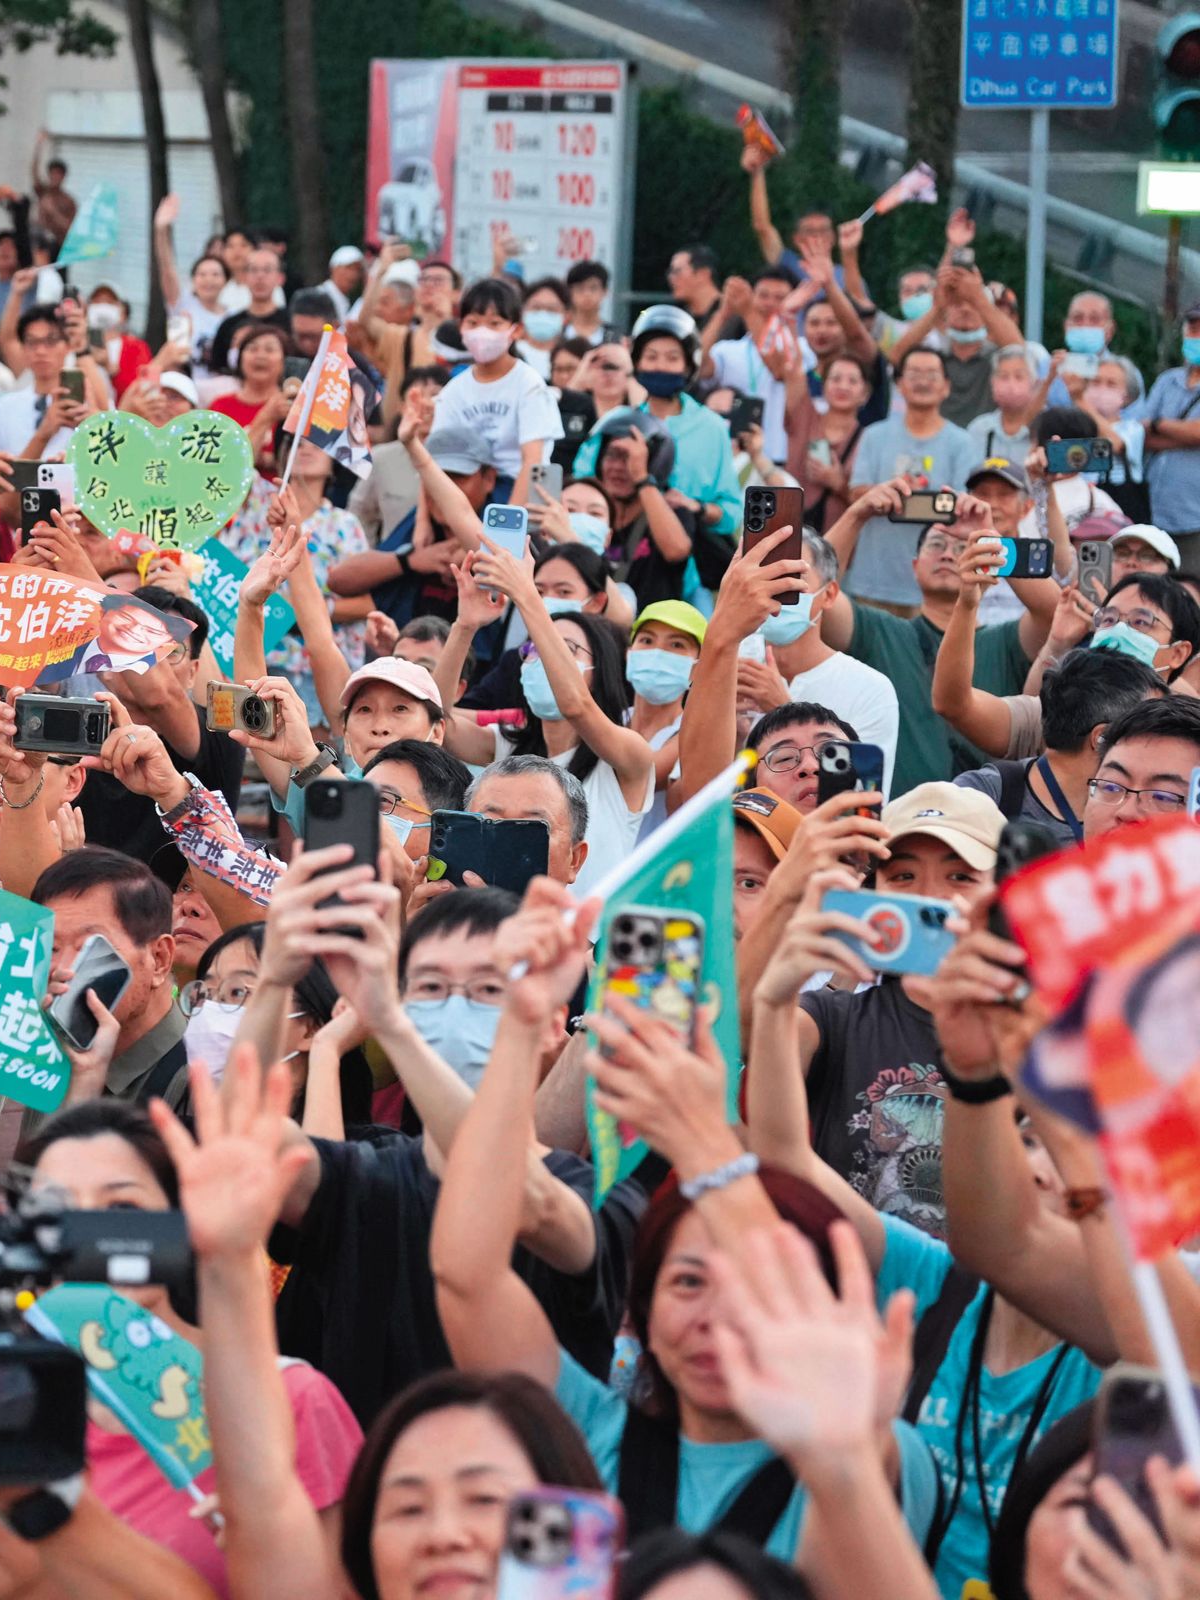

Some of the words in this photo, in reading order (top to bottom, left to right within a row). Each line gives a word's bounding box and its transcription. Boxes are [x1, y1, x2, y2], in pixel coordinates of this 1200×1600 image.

[973, 32, 1108, 58] 平面停車場
[1026, 78, 1056, 96] Car
[1066, 77, 1107, 96] Park
[4, 1056, 61, 1092] SOON
